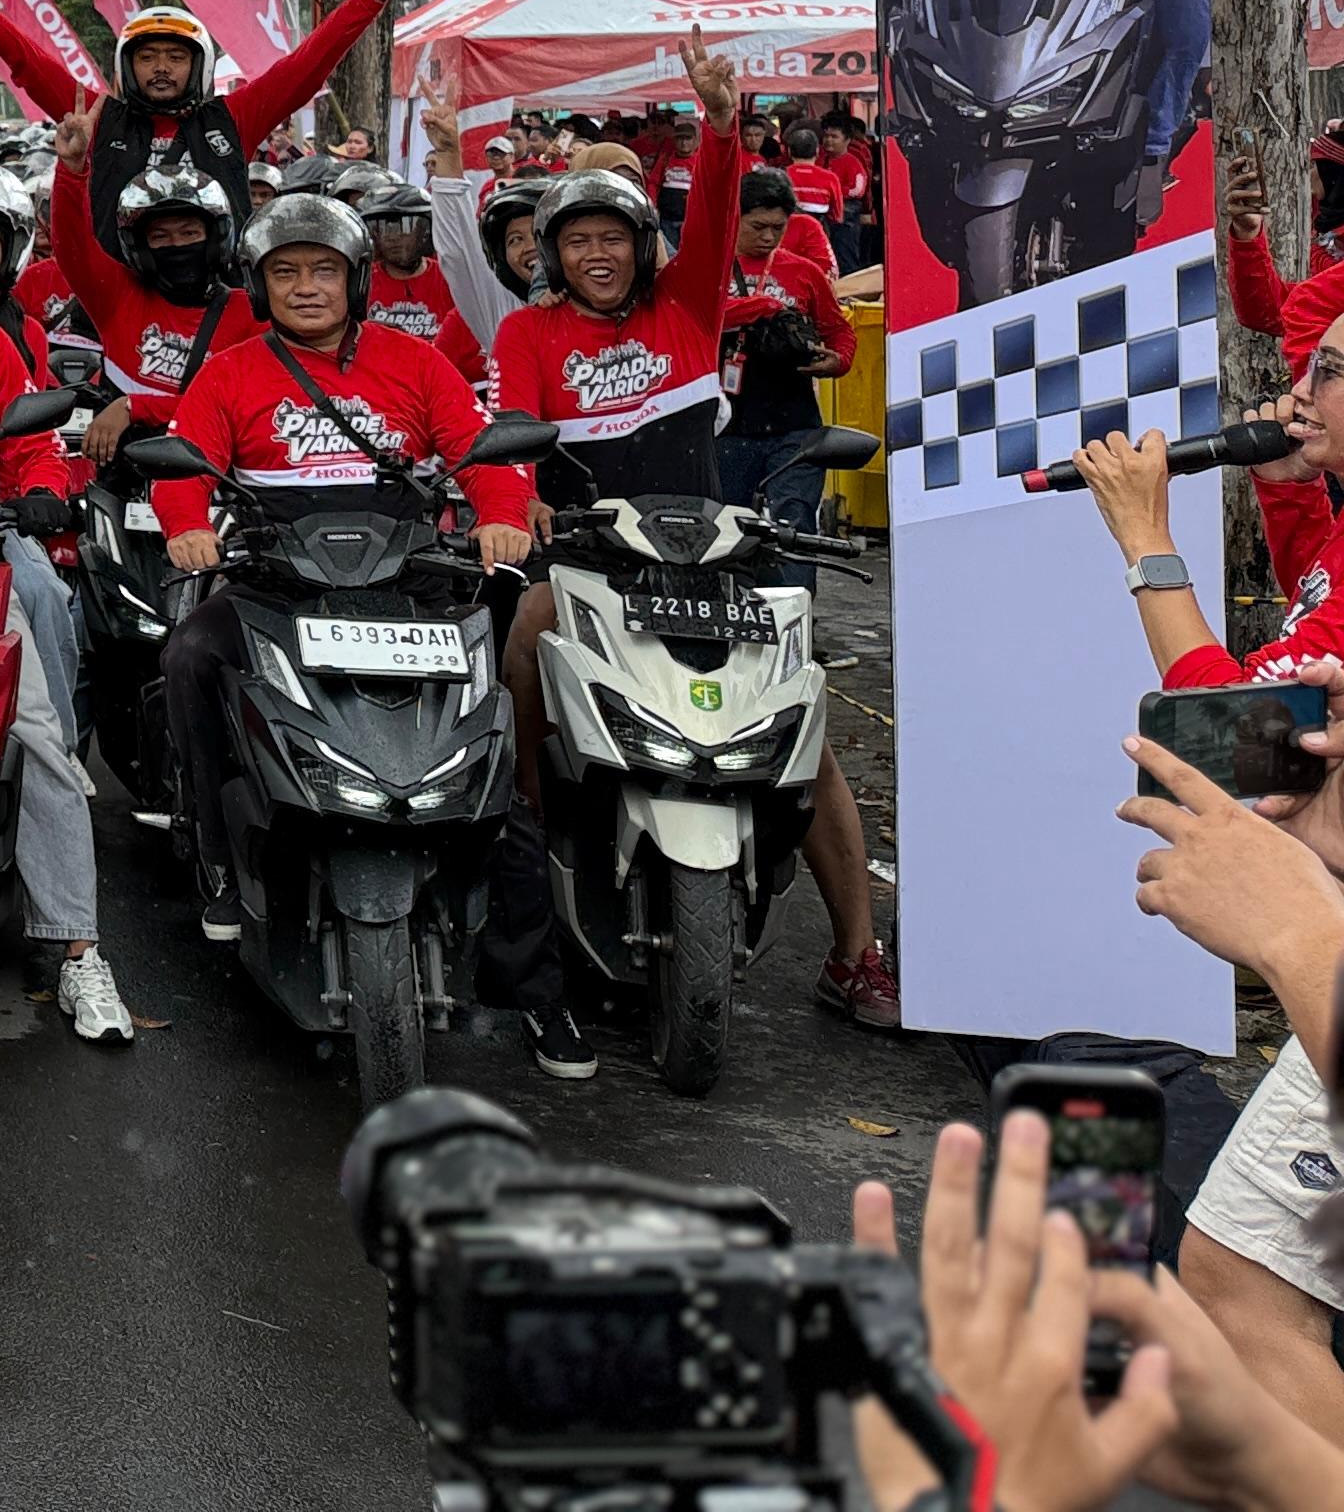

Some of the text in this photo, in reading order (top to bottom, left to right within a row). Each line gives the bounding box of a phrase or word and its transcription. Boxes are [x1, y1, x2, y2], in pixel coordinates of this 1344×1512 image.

[648, 3, 876, 23] HONDA
[141, 338, 191, 366] PARA
[279, 413, 383, 438] PARDE
[315, 469, 372, 479] HOND
[661, 516, 695, 524] HONDA
[624, 594, 773, 625] L 2218 BAE
[306, 623, 458, 646] L 6393 DAH
